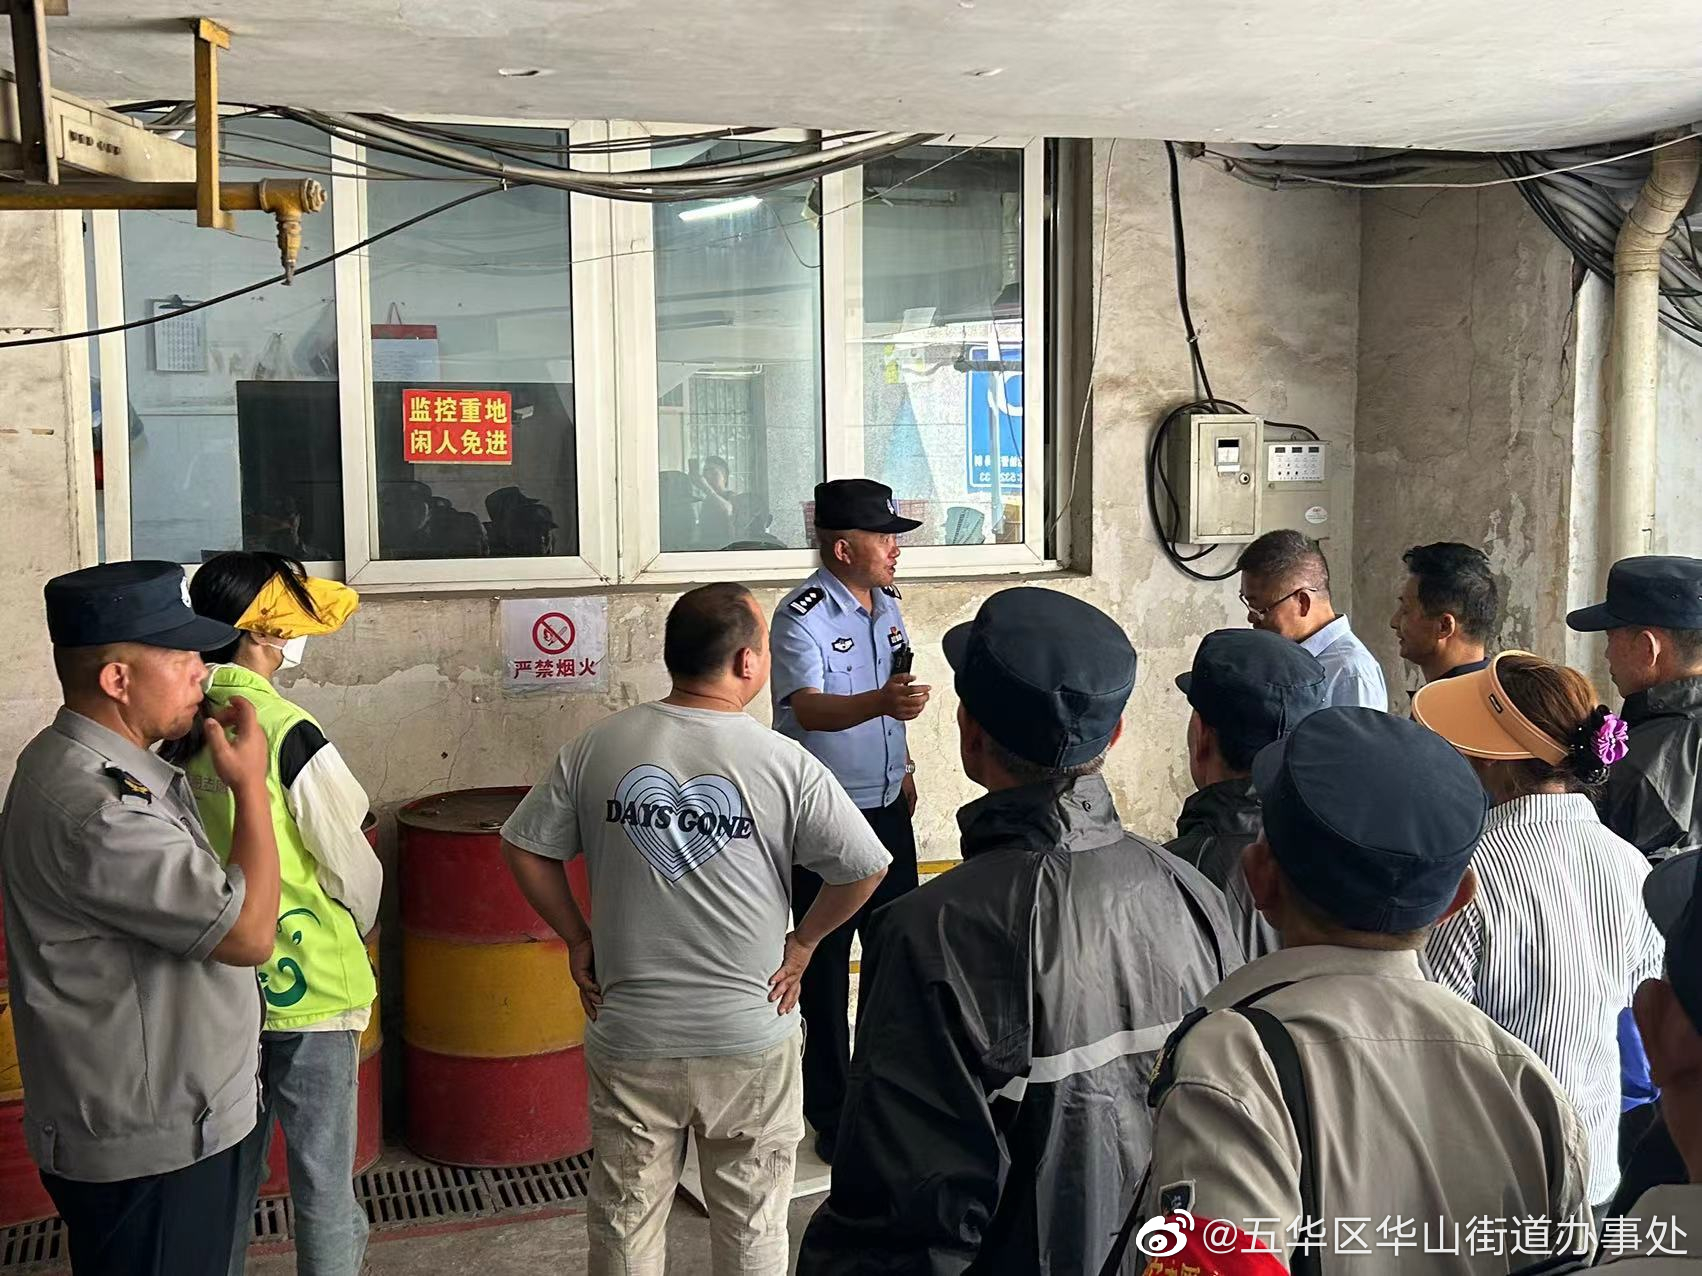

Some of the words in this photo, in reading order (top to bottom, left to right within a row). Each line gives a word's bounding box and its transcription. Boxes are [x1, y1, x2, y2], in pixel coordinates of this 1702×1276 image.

[409, 397, 508, 424] 监控重地
[410, 429, 508, 455] 闲人免进
[513, 658, 597, 679] 严禁烟火
[606, 800, 673, 829] DAYS
[678, 809, 754, 839] GONE
